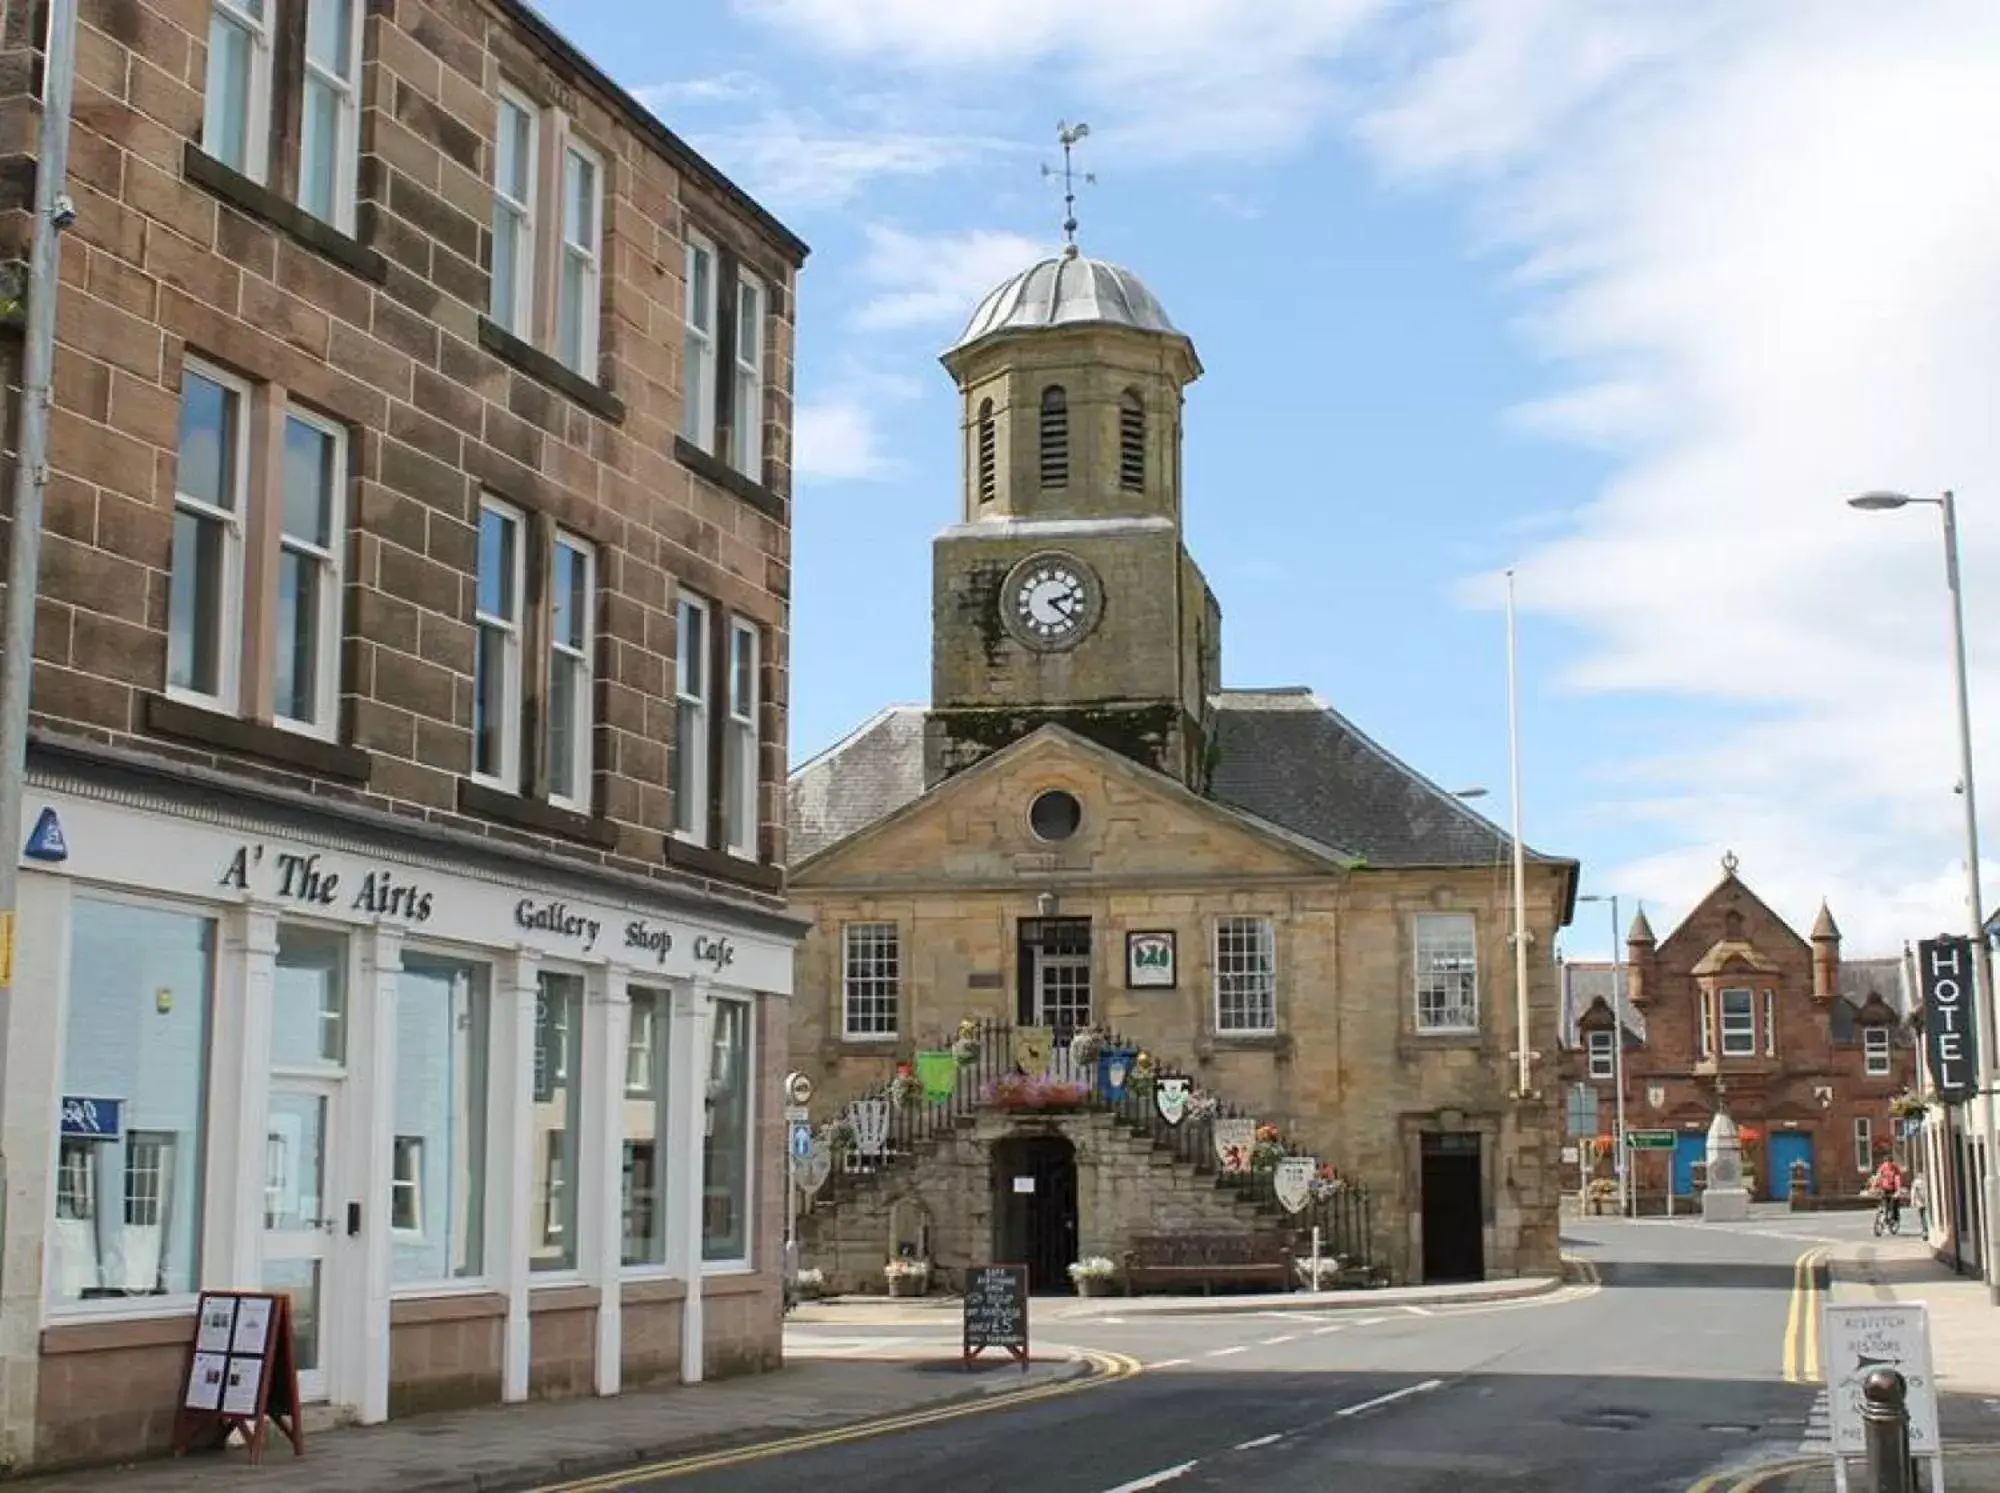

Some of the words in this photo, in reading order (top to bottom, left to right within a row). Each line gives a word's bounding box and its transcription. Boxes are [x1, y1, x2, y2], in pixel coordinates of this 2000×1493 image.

[219, 844, 264, 889] A'
[277, 853, 339, 904] The
[352, 871, 433, 921] Airts
[515, 898, 600, 951] Gallery
[625, 920, 672, 964] Shop
[694, 934, 735, 973] Cafe
[1931, 948, 1966, 1089] HOTEL
